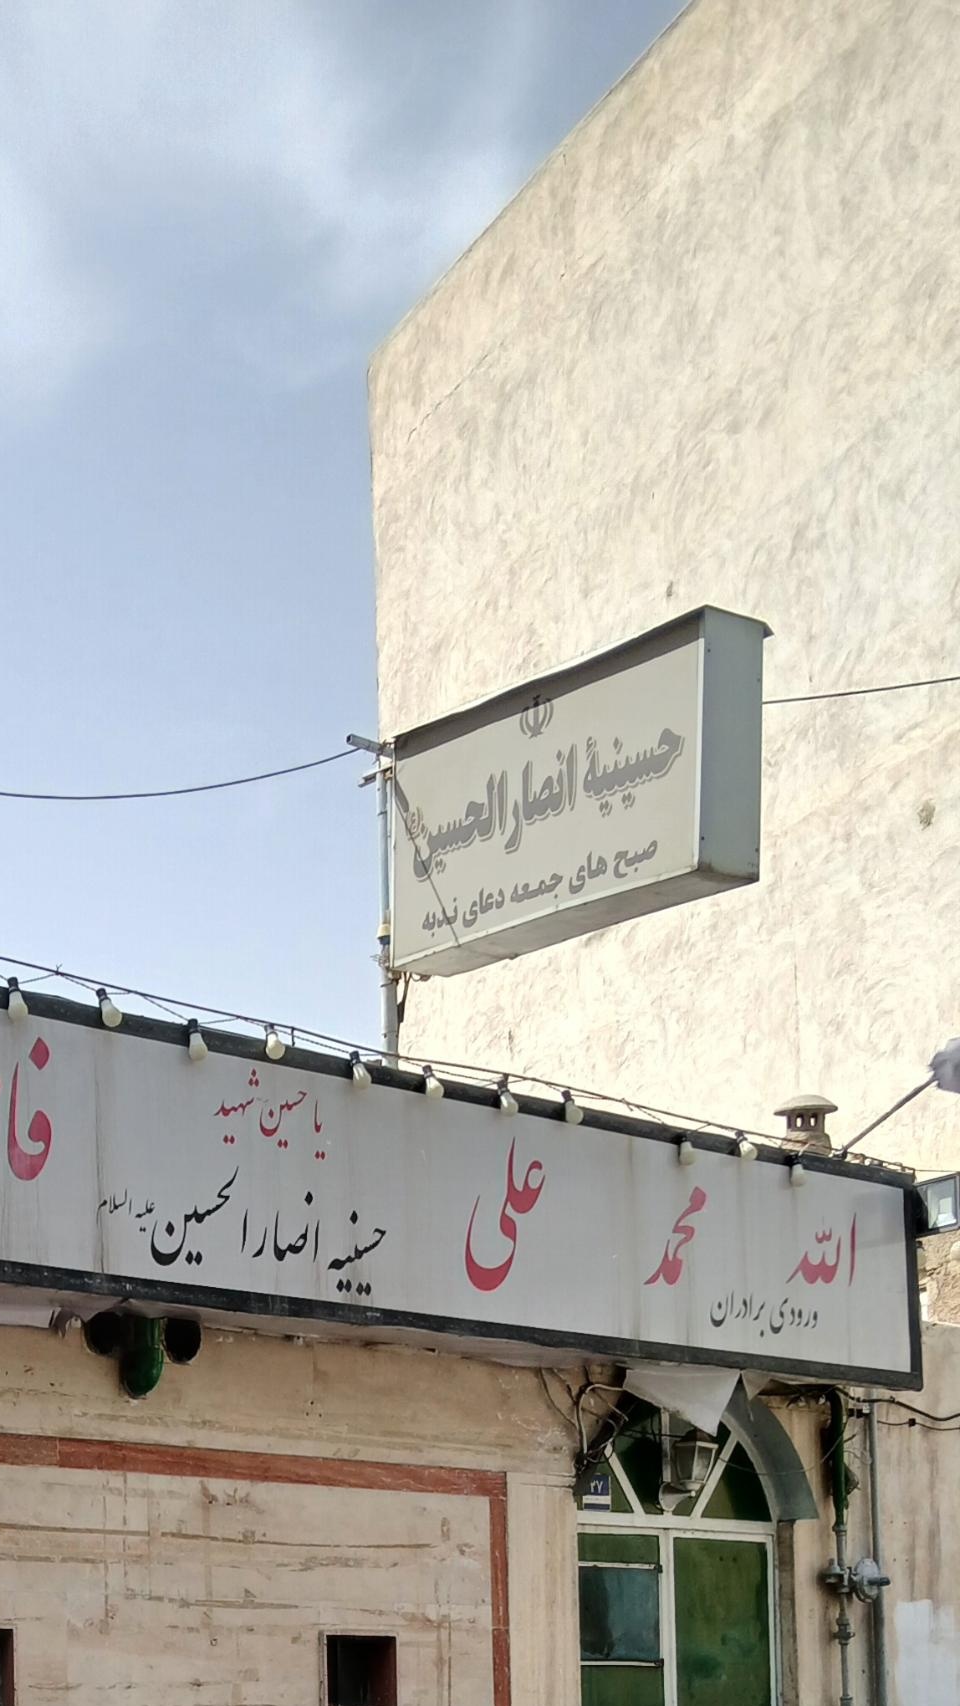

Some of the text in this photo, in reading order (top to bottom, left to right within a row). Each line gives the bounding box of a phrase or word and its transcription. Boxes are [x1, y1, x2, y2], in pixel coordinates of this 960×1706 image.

[413, 770, 508, 882] الحسین
[503, 743, 578, 855] انصار
[422, 839, 658, 938] صبح های جمعه دعای ندبه
[214, 1068, 326, 1160] یا حسین شهید
[97, 1165, 387, 1297] حسینیه انصار الحسین علیه السلام
[464, 1136, 546, 1294] علی
[643, 1186, 709, 1287] محمد
[709, 1290, 818, 1338] ورودی برادران
